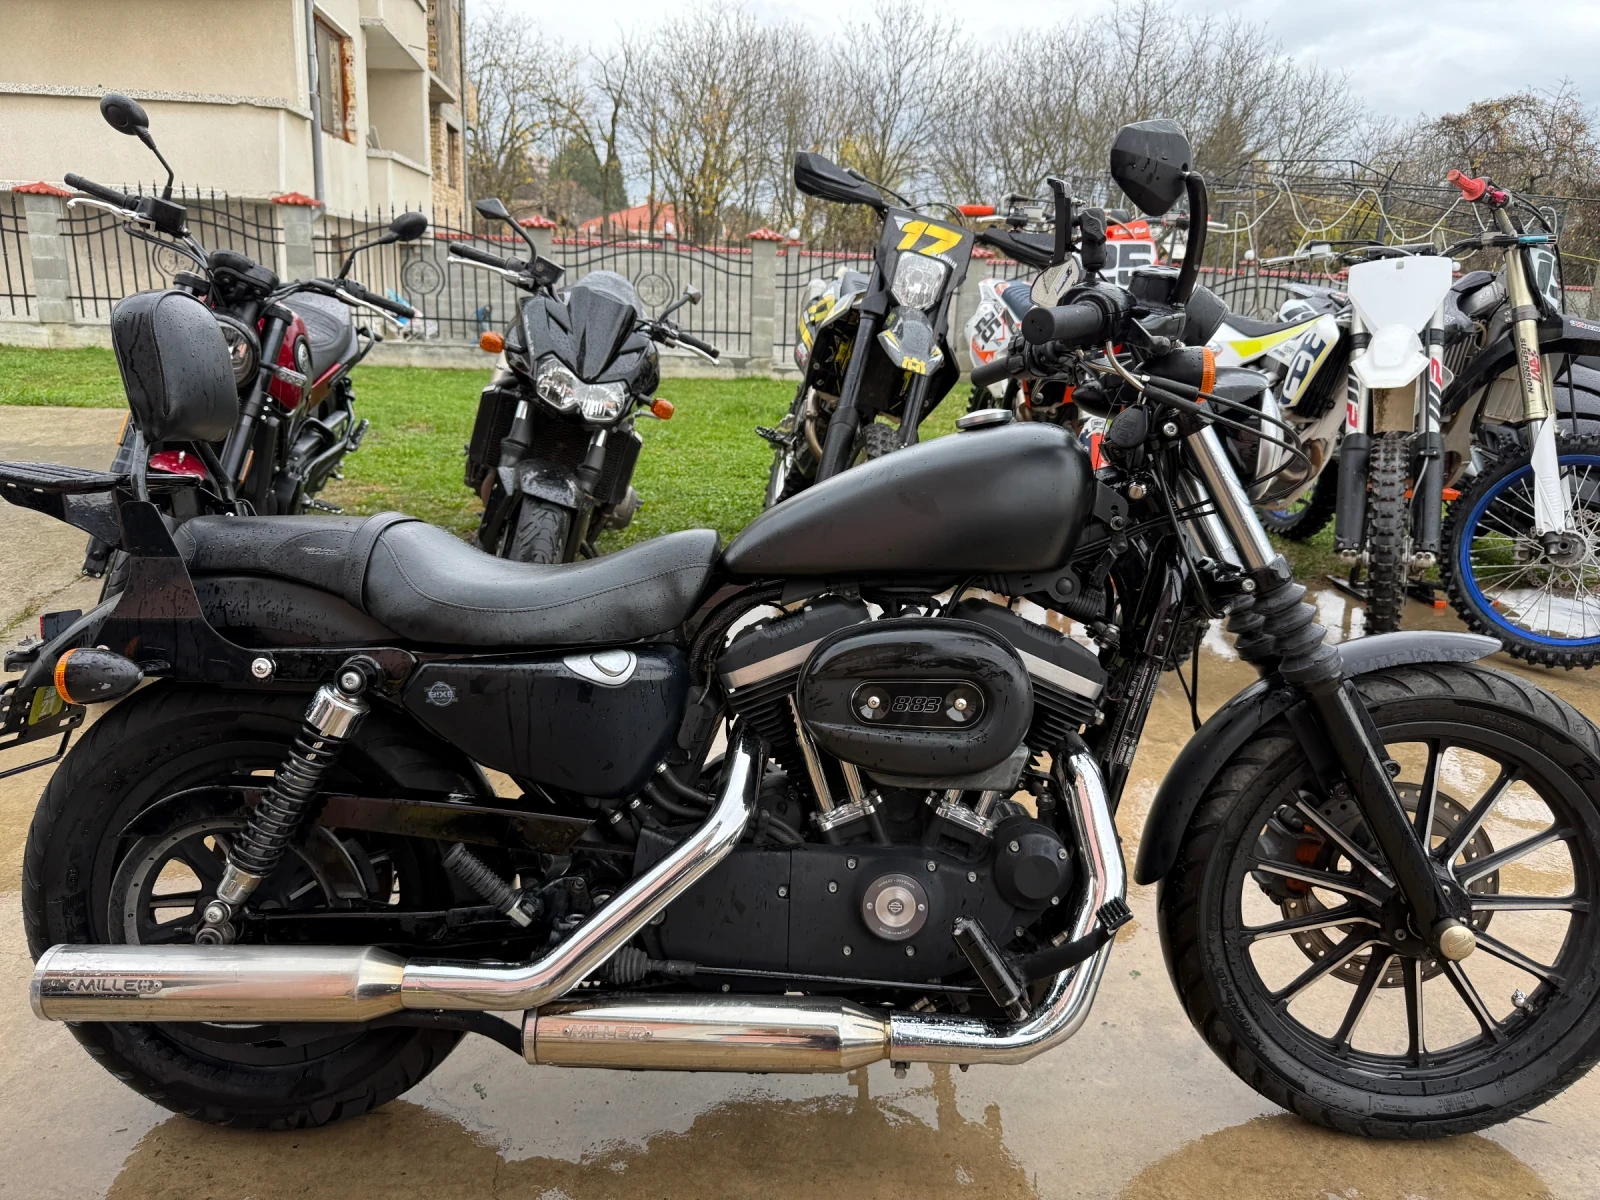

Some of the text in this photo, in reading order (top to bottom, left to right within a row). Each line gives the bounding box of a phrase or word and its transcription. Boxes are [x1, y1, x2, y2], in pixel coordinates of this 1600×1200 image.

[896, 219, 963, 256] 17
[974, 311, 1002, 344] 25
[1519, 337, 1535, 394] SUSPENSION
[891, 695, 943, 714] 883
[76, 978, 156, 993] MILLER
